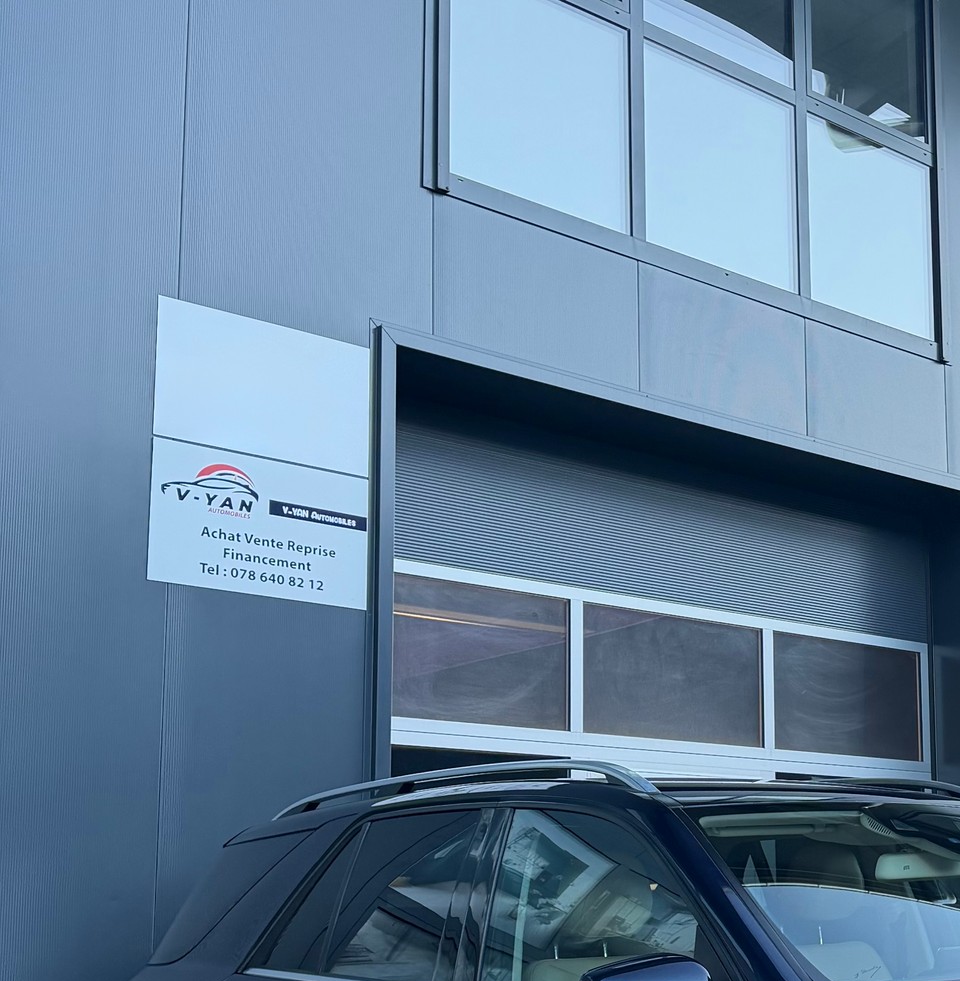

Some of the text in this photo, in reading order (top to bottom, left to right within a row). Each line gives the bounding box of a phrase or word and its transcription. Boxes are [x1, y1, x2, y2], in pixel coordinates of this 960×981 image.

[176, 487, 254, 513] V-YAN
[282, 505, 309, 519] V-YAN
[207, 507, 251, 520] AUTOMOBILES
[201, 526, 337, 558] Achat Vente Reprise
[223, 548, 312, 572] Financement
[230, 567, 256, 581] 078
[260, 571, 285, 585] 640
[288, 576, 305, 588] 82
[308, 579, 324, 591] 12
